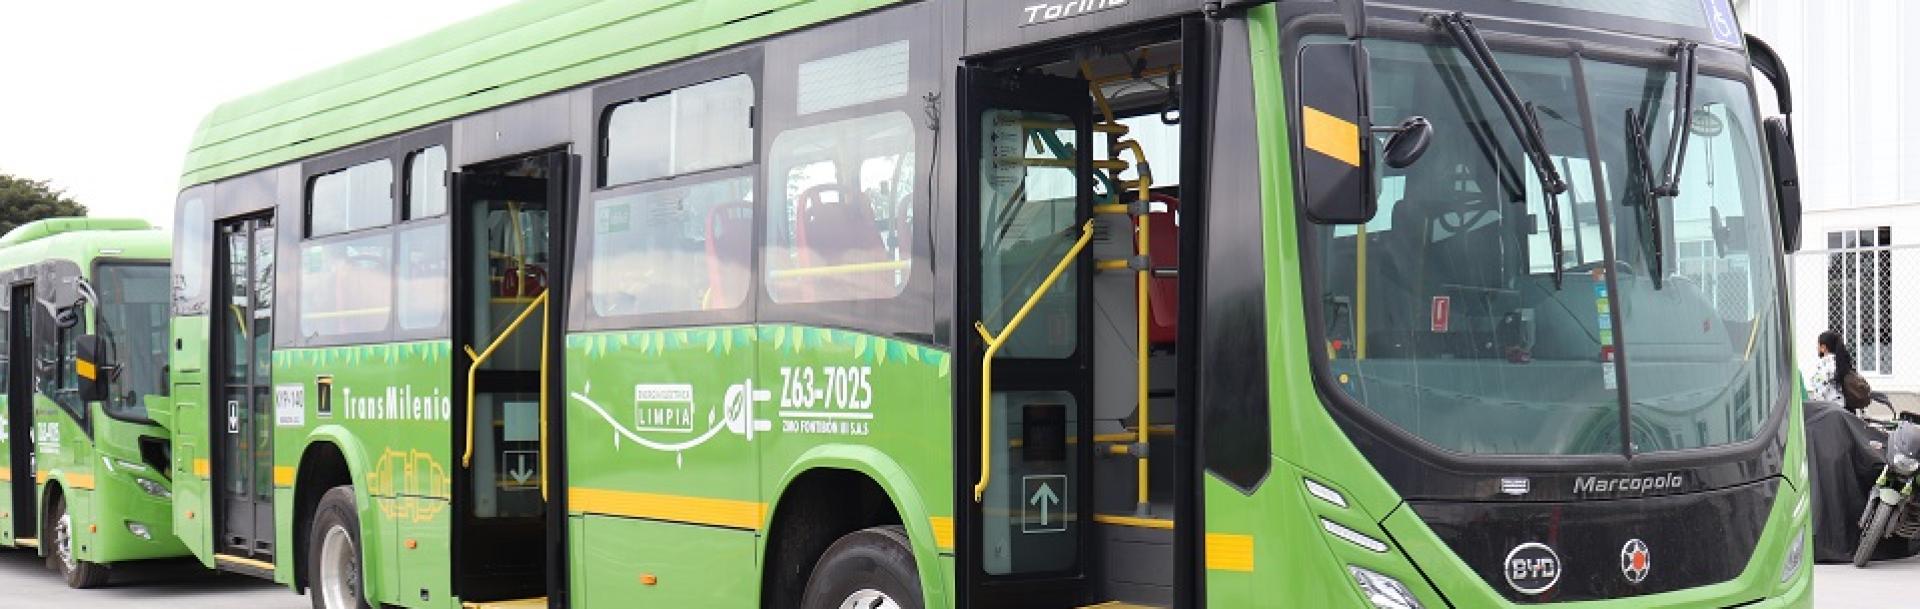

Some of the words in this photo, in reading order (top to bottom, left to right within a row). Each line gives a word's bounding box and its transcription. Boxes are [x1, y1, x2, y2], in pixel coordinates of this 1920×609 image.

[780, 366, 872, 410] Z63-7025
[343, 384, 451, 420] TransMilenio
[640, 407, 690, 426] LIMPIA
[1573, 472, 1683, 495] Marcopolo
[1511, 557, 1555, 580] BYD
